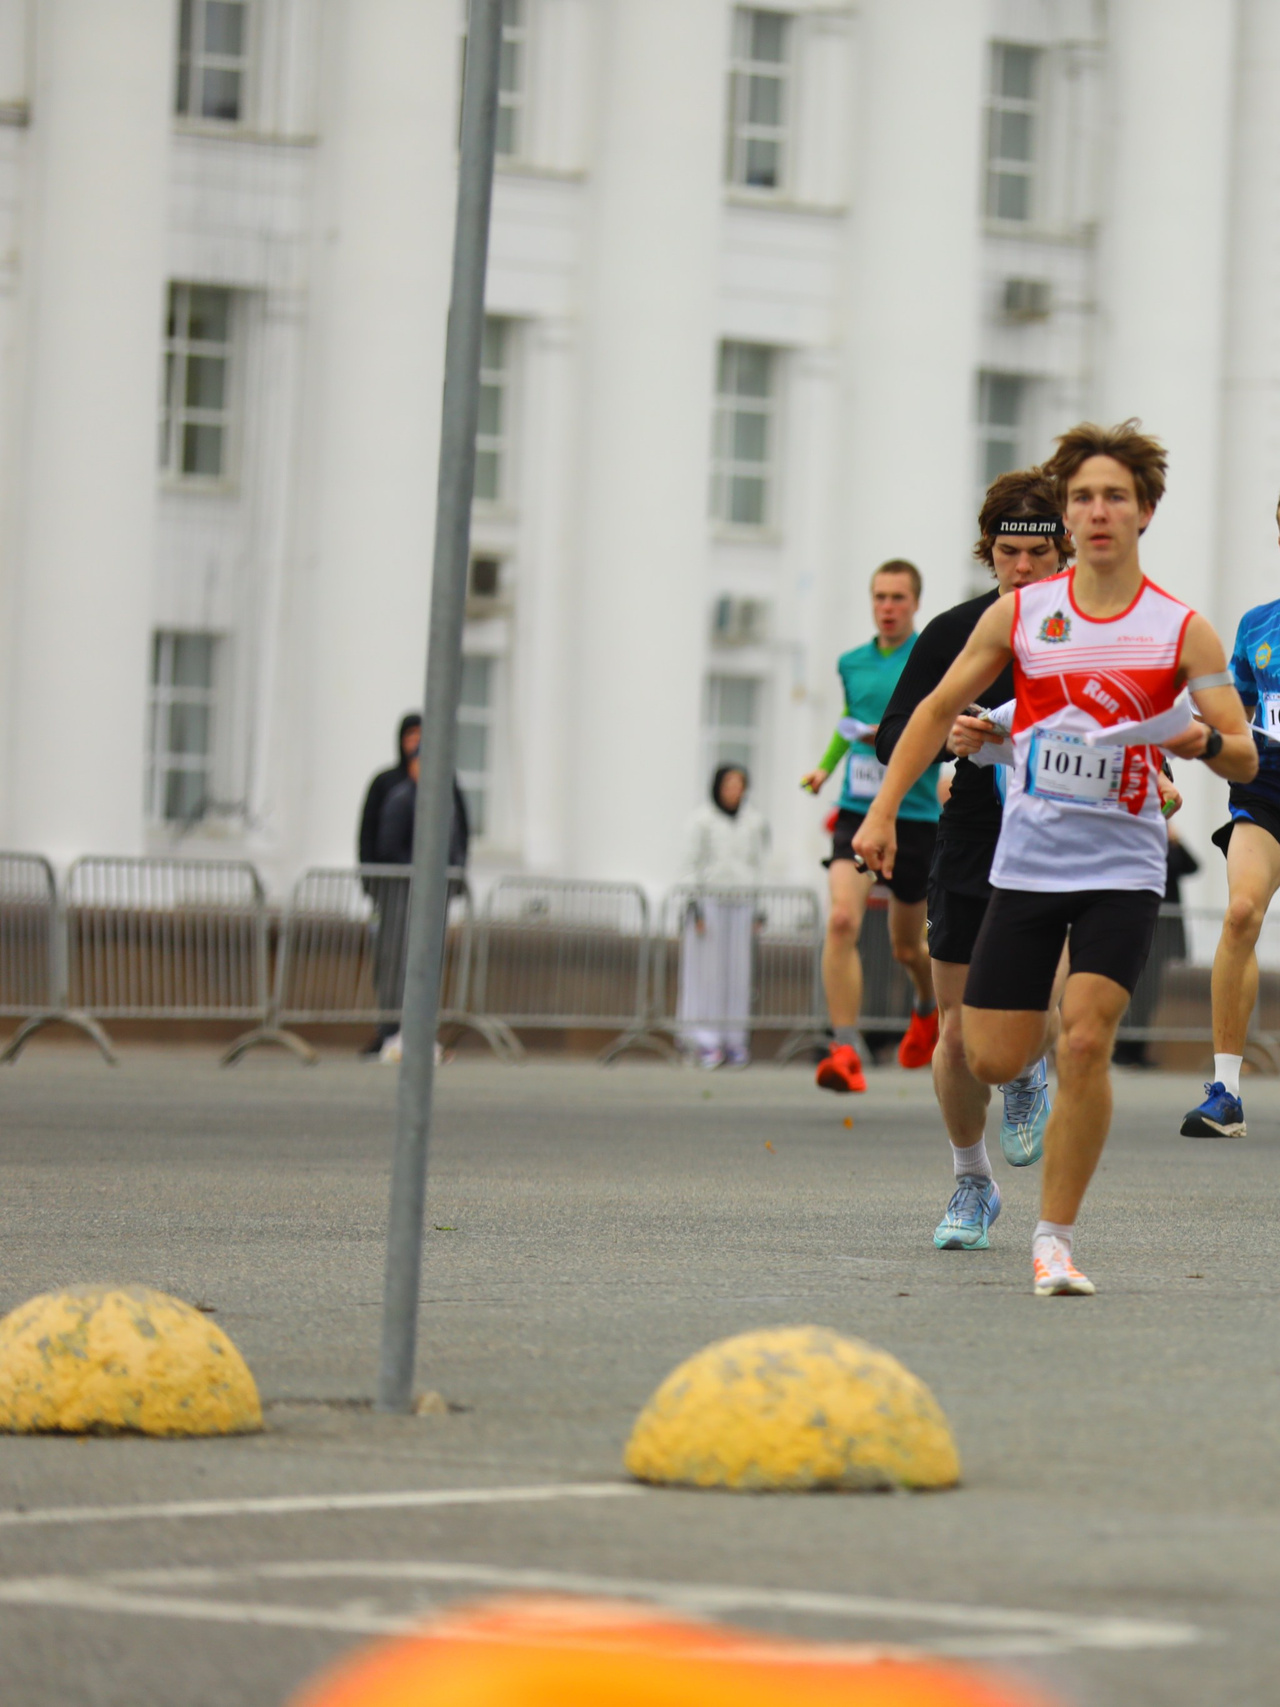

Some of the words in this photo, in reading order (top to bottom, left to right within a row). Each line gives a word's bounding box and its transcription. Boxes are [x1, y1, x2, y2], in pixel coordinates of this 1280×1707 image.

[1000, 521, 1057, 532] noname
[1082, 679, 1120, 714] Run
[1042, 749, 1106, 780] 101.1
